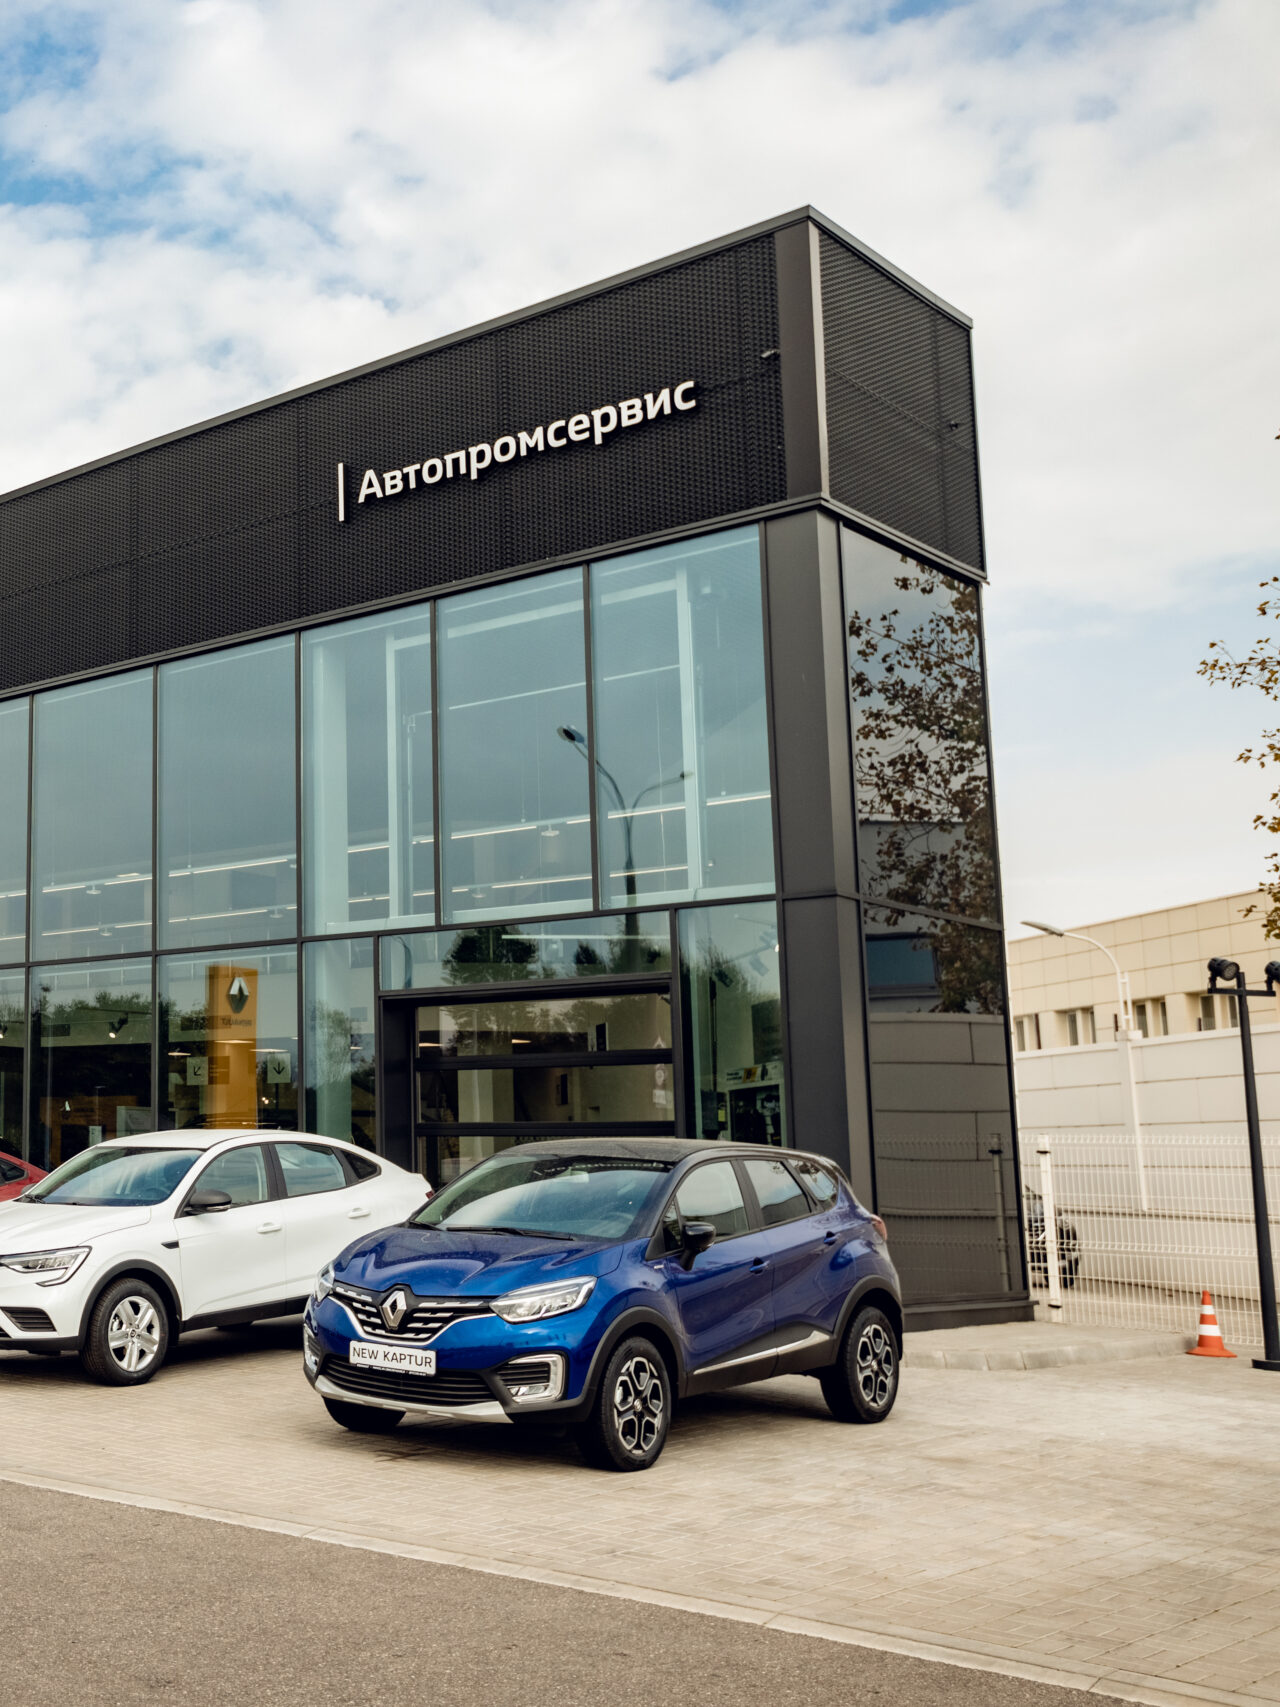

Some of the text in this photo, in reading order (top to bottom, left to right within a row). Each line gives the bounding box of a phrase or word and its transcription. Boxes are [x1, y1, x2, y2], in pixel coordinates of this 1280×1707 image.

[358, 380, 696, 504] Автопромсервис
[352, 1346, 432, 1368] NEW KAPTUR
